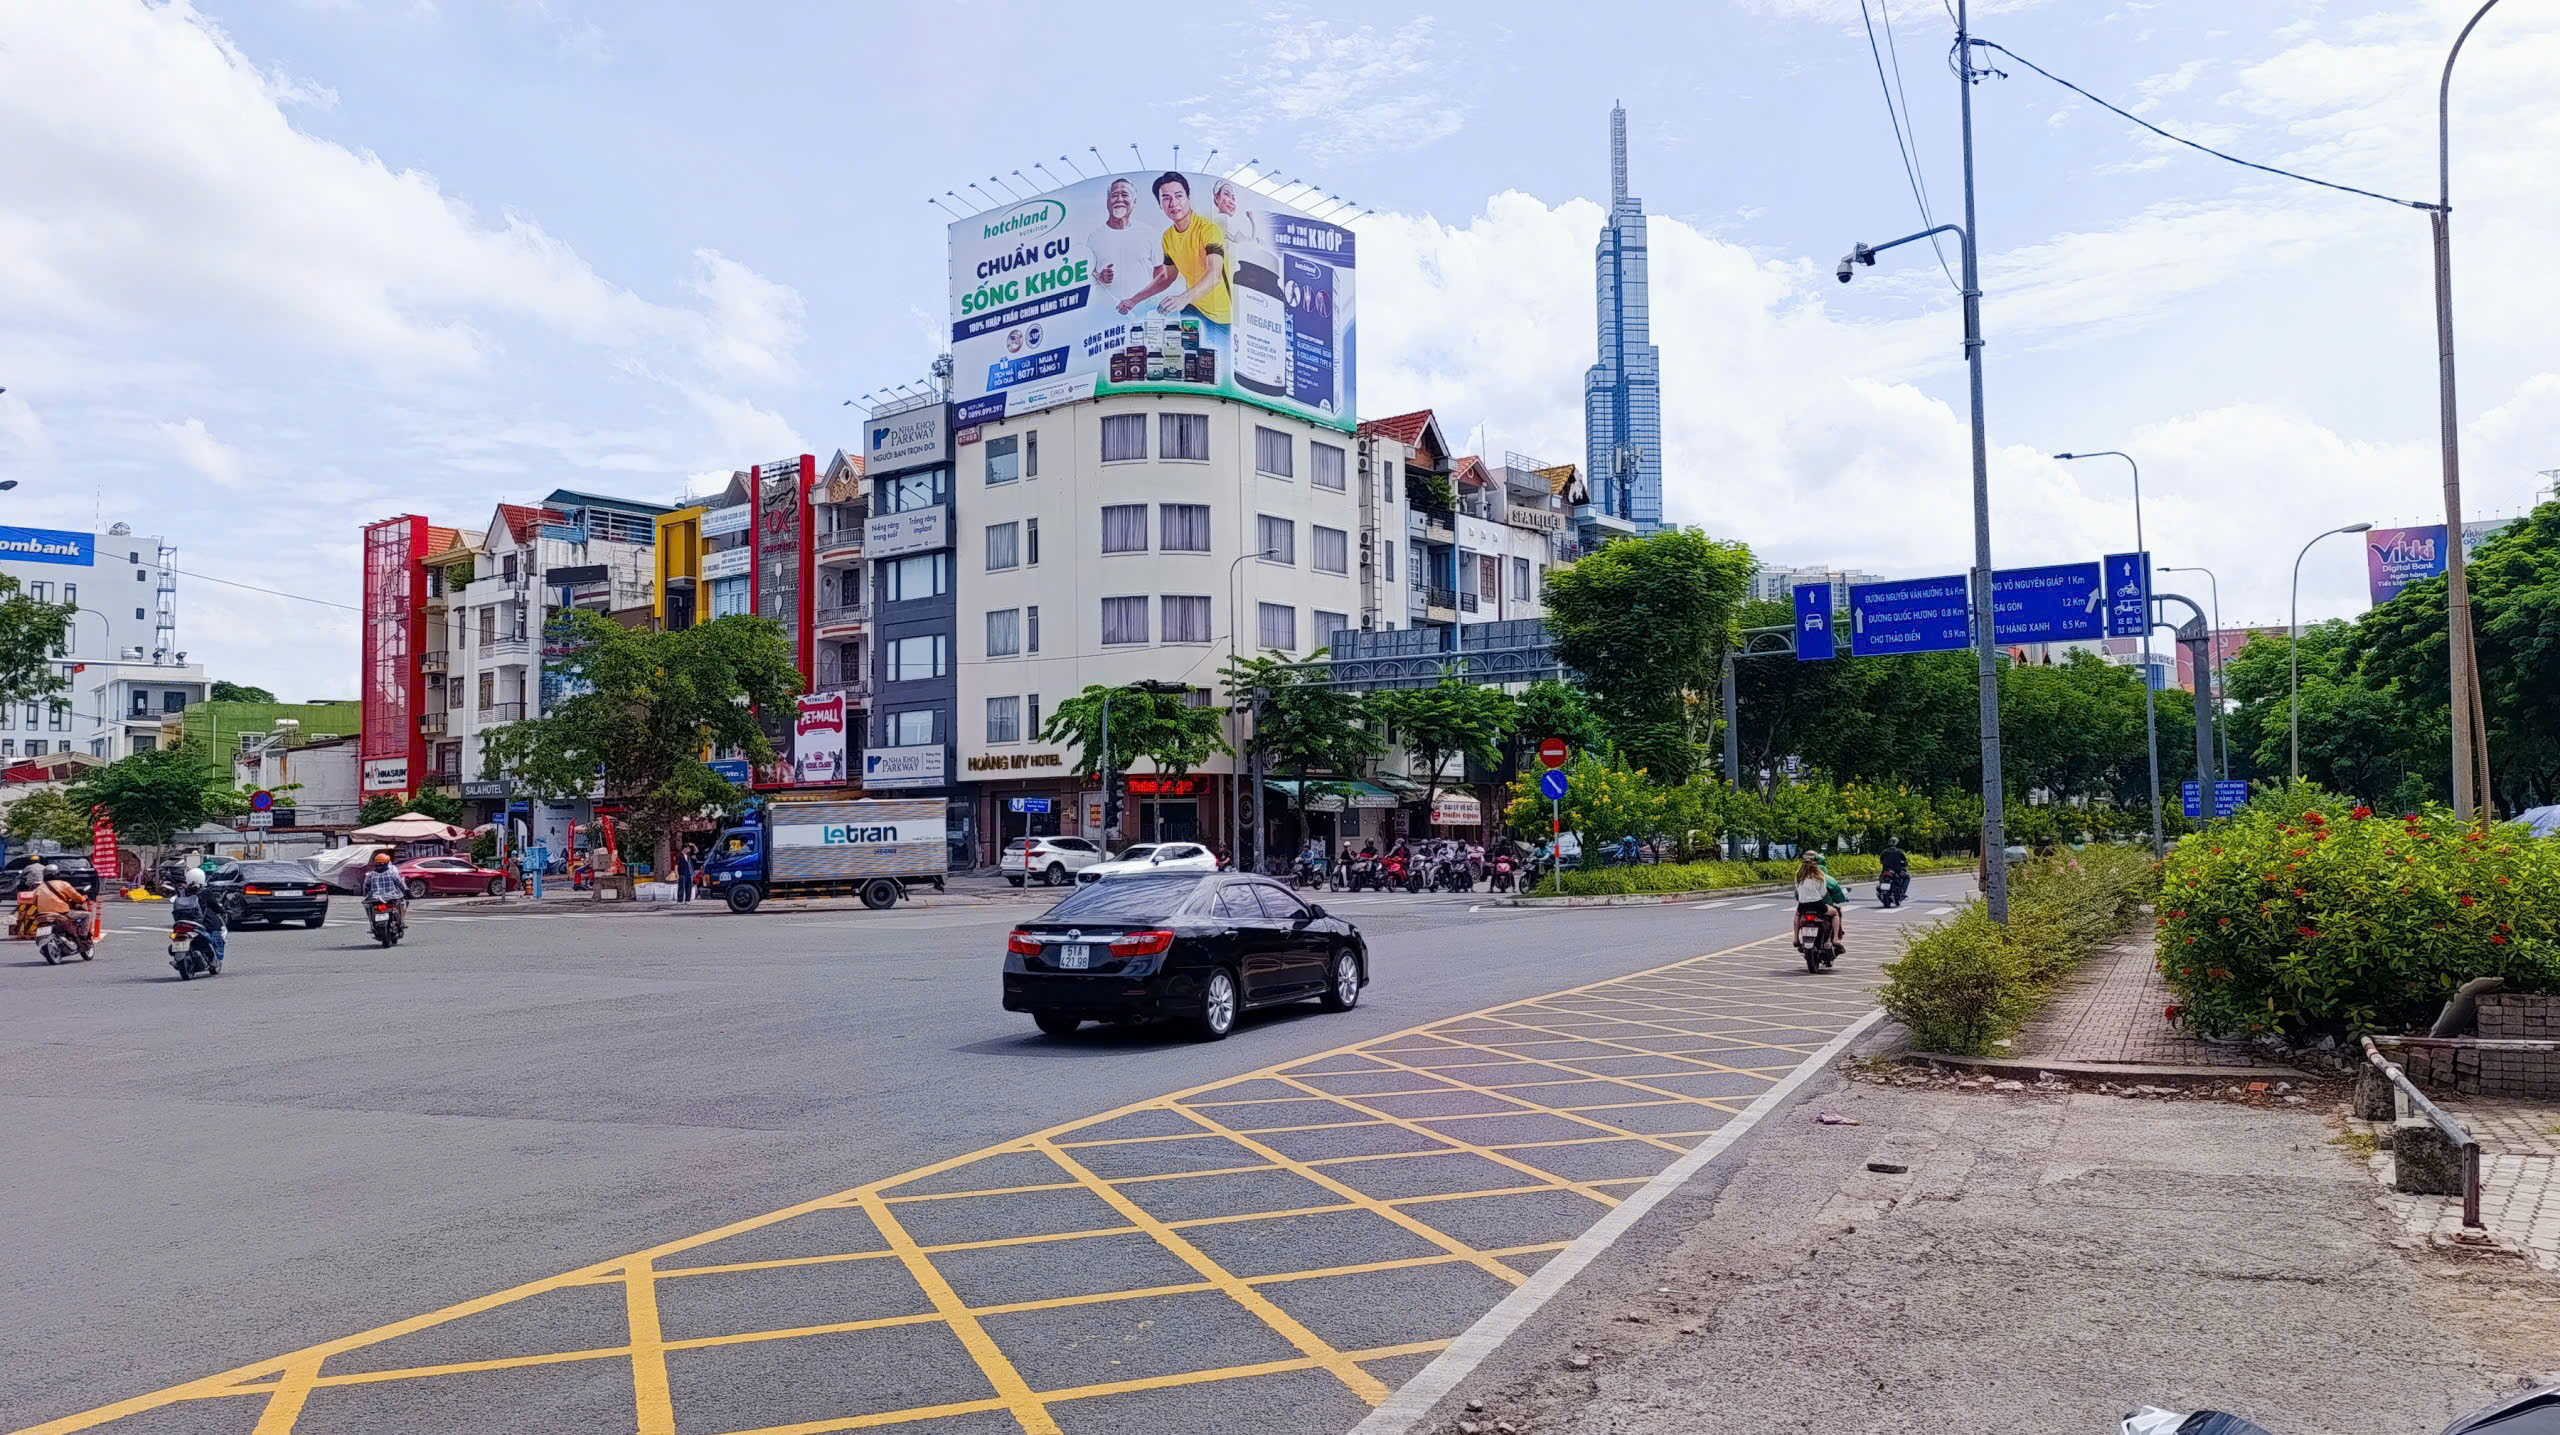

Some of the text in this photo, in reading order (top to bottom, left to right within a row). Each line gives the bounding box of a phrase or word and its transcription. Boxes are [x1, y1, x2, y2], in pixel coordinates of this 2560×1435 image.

[984, 205, 1048, 239] hotchland
[1308, 228, 1342, 252] KHỚP
[976, 237, 1070, 279] CHUẨN GU
[961, 257, 1089, 315] SỐNG KHỎE
[1246, 313, 1282, 334] MEGAFLEX
[1038, 353, 1059, 364] MUA 9
[916, 420, 935, 431] KHOA
[1512, 510, 1528, 525] SPA
[2370, 531, 2435, 564] Vikki
[2382, 562, 2434, 574] Digital Bank
[2072, 575, 2085, 585] Km
[1954, 586, 1965, 596] Km
[1952, 607, 1964, 616] Km
[1993, 600, 2006, 613] SÀI
[2007, 599, 2023, 612] GÒN
[2072, 597, 2086, 607] Km
[2006, 621, 2028, 634] HÀNG
[2028, 621, 2050, 632] XANH
[2074, 619, 2087, 629] Km
[1954, 629, 1966, 638] Km
[967, 752, 1009, 772] HOÀNG
[1030, 753, 1063, 768] HOTEL
[465, 784, 503, 796] SALA HOTEL
[1067, 946, 1083, 957] 51A
[1060, 957, 1088, 968] 421.98
